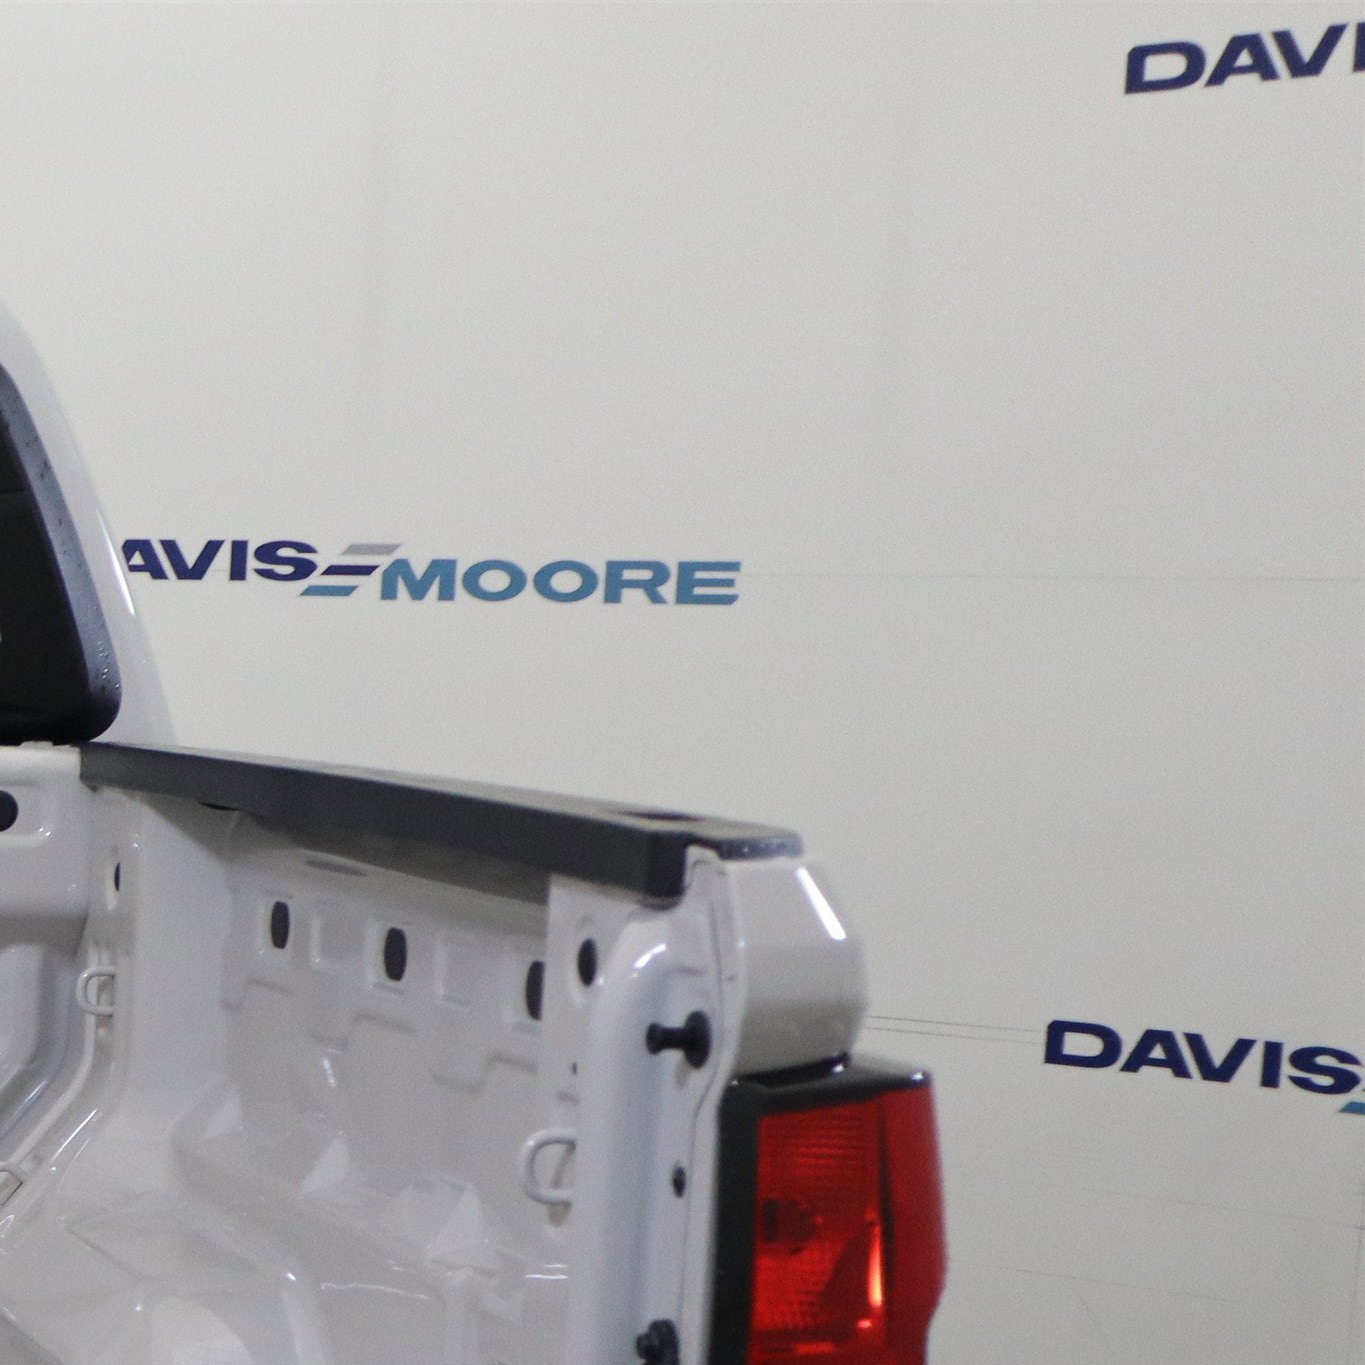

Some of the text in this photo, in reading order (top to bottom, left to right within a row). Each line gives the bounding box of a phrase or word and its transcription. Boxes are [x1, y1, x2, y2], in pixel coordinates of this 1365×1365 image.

[122, 538, 742, 606] AVIS MOORE
[1043, 1019, 1362, 1095] DAVIS
